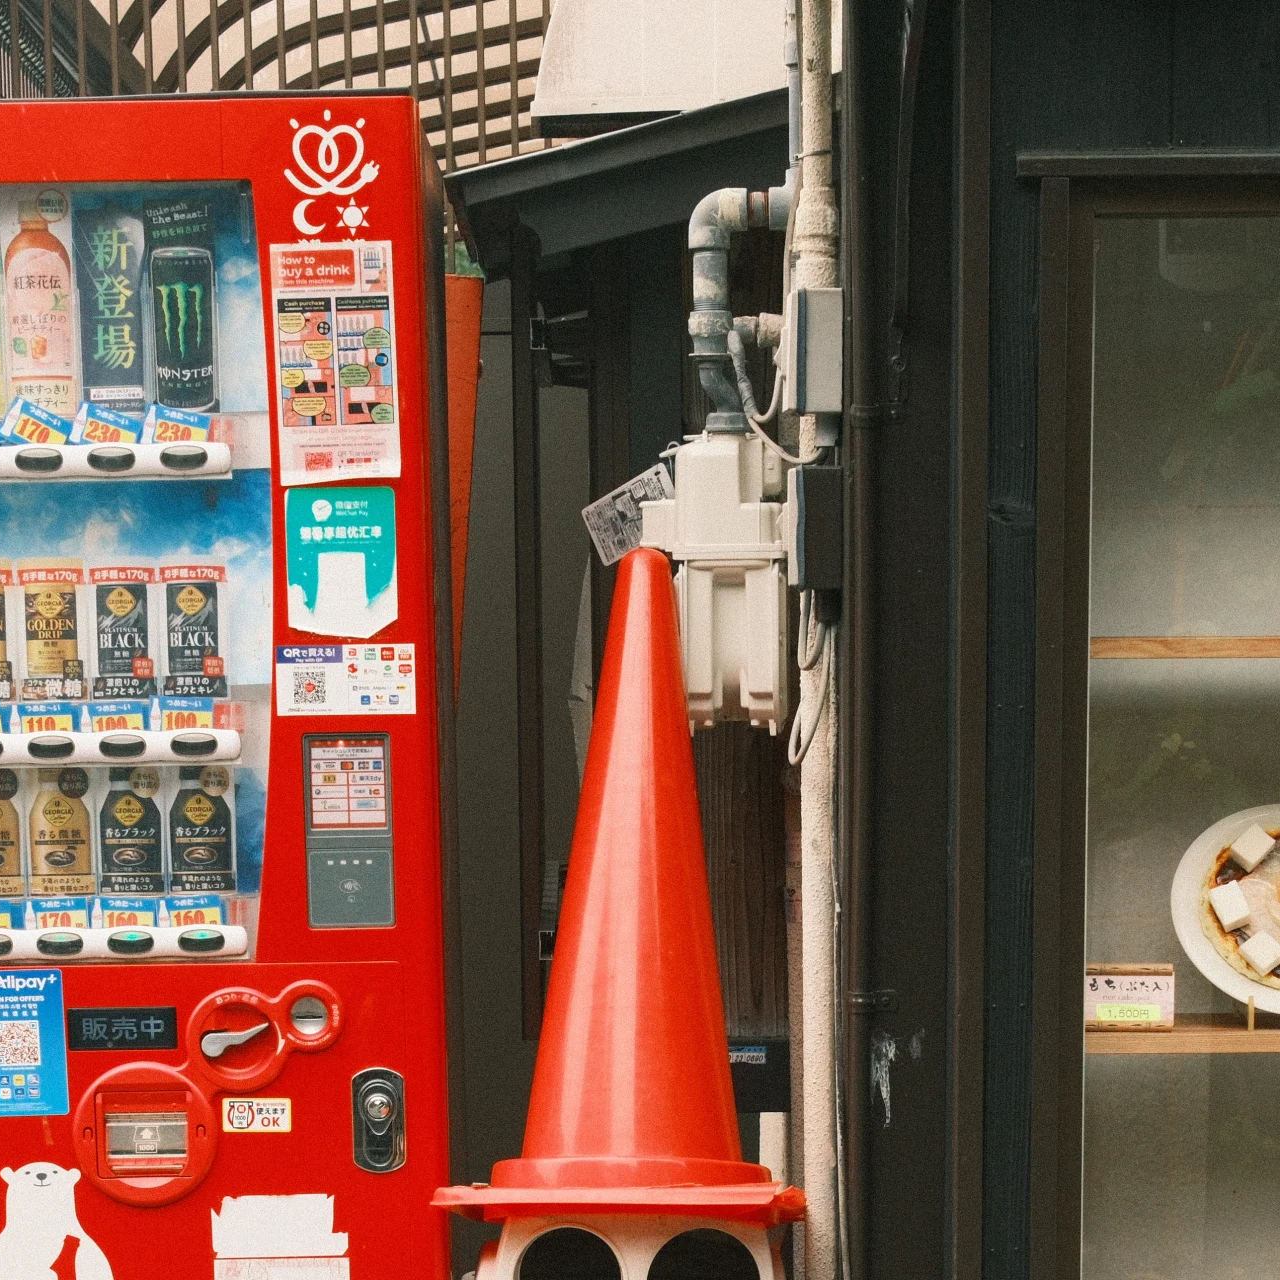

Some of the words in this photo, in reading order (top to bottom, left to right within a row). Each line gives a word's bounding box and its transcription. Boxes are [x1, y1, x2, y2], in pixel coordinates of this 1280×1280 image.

[145, 202, 188, 218] Unleash
[152, 211, 171, 224] the
[174, 206, 208, 221] Beast!
[278, 256, 302, 265] How
[304, 256, 315, 264] to
[279, 267, 302, 278] buy
[305, 268, 313, 276] a
[317, 265, 350, 275] drink
[13, 275, 61, 290] 紅茶花伝
[91, 225, 136, 370] 新登場
[158, 365, 213, 381] MONSTER
[15, 384, 69, 396] 後味すっきり
[22, 571, 78, 583] お手軽な170g
[93, 570, 149, 582] お手軽な170g
[164, 569, 219, 581] お手軽な170g
[27, 619, 74, 632] GOLDEN
[38, 630, 63, 639] DRIP
[99, 632, 145, 648] BLACK
[170, 631, 216, 647] BLACK
[44, 679, 82, 699] 微糖
[105, 687, 143, 695] コクとキレ
[176, 685, 213, 695] コクとキレ
[44, 808, 73, 816] GEORGIA
[115, 807, 143, 815] GEORGIA
[184, 806, 213, 814] GEORGIA
[38, 829, 81, 840] 香る微糖
[105, 827, 156, 838] 香るブラック
[176, 826, 227, 837] 香るブラック
[1107, 1009, 1150, 1019] 1,500円
[82, 1016, 165, 1041] 販売中
[256, 1106, 287, 1115] 使えます
[261, 1116, 280, 1127] OK
